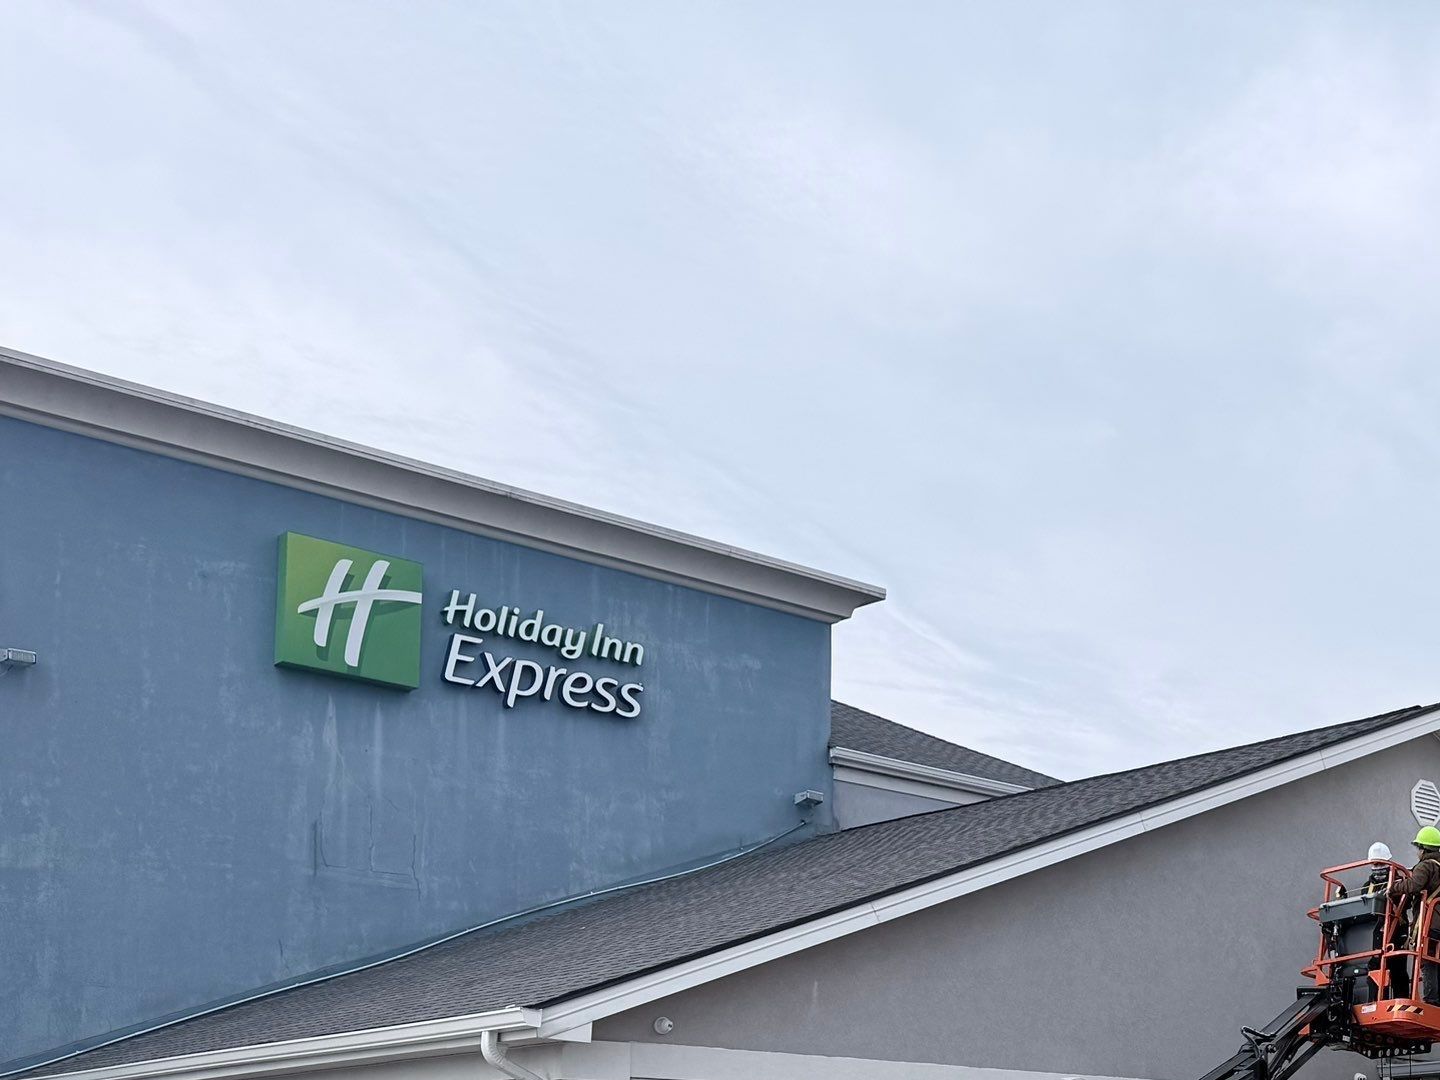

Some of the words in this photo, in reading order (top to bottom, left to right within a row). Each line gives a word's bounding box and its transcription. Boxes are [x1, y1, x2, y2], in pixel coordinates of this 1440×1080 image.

[443, 589, 587, 661] Holiday
[591, 623, 645, 666] Inn
[443, 633, 644, 719] Express
